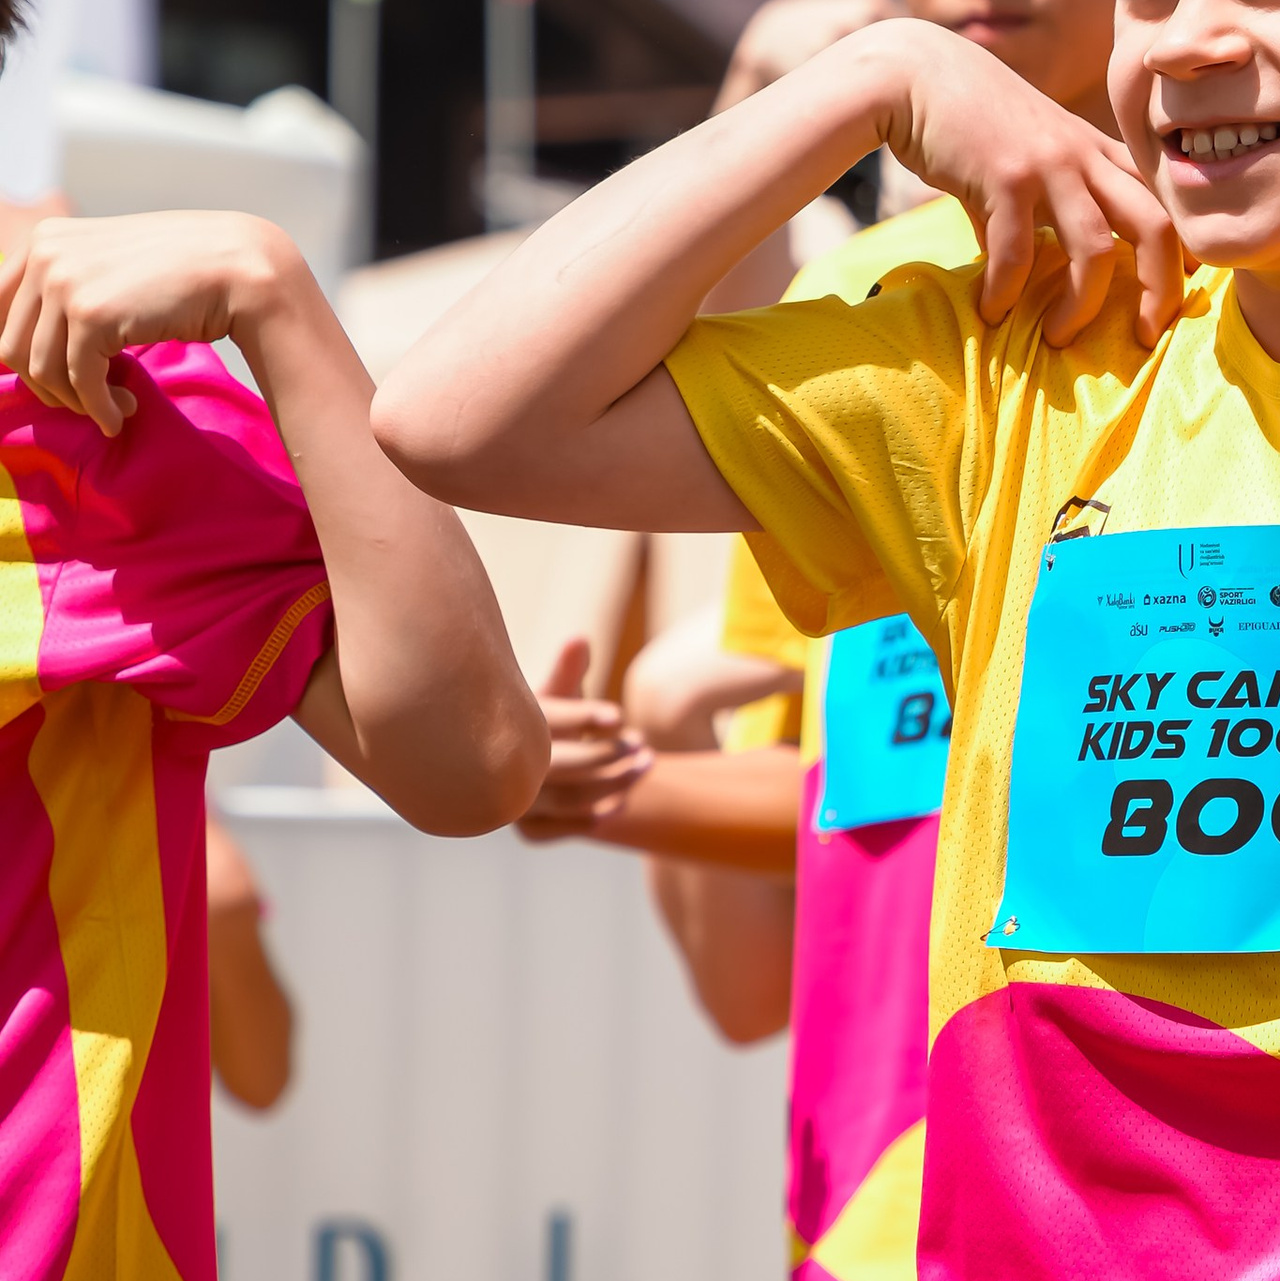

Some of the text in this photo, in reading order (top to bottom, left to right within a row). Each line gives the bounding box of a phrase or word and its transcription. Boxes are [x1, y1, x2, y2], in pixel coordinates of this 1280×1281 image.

[1153, 595, 1186, 605] xazna
[1082, 671, 1177, 713] SKY
[1077, 719, 1193, 762] KIDS
